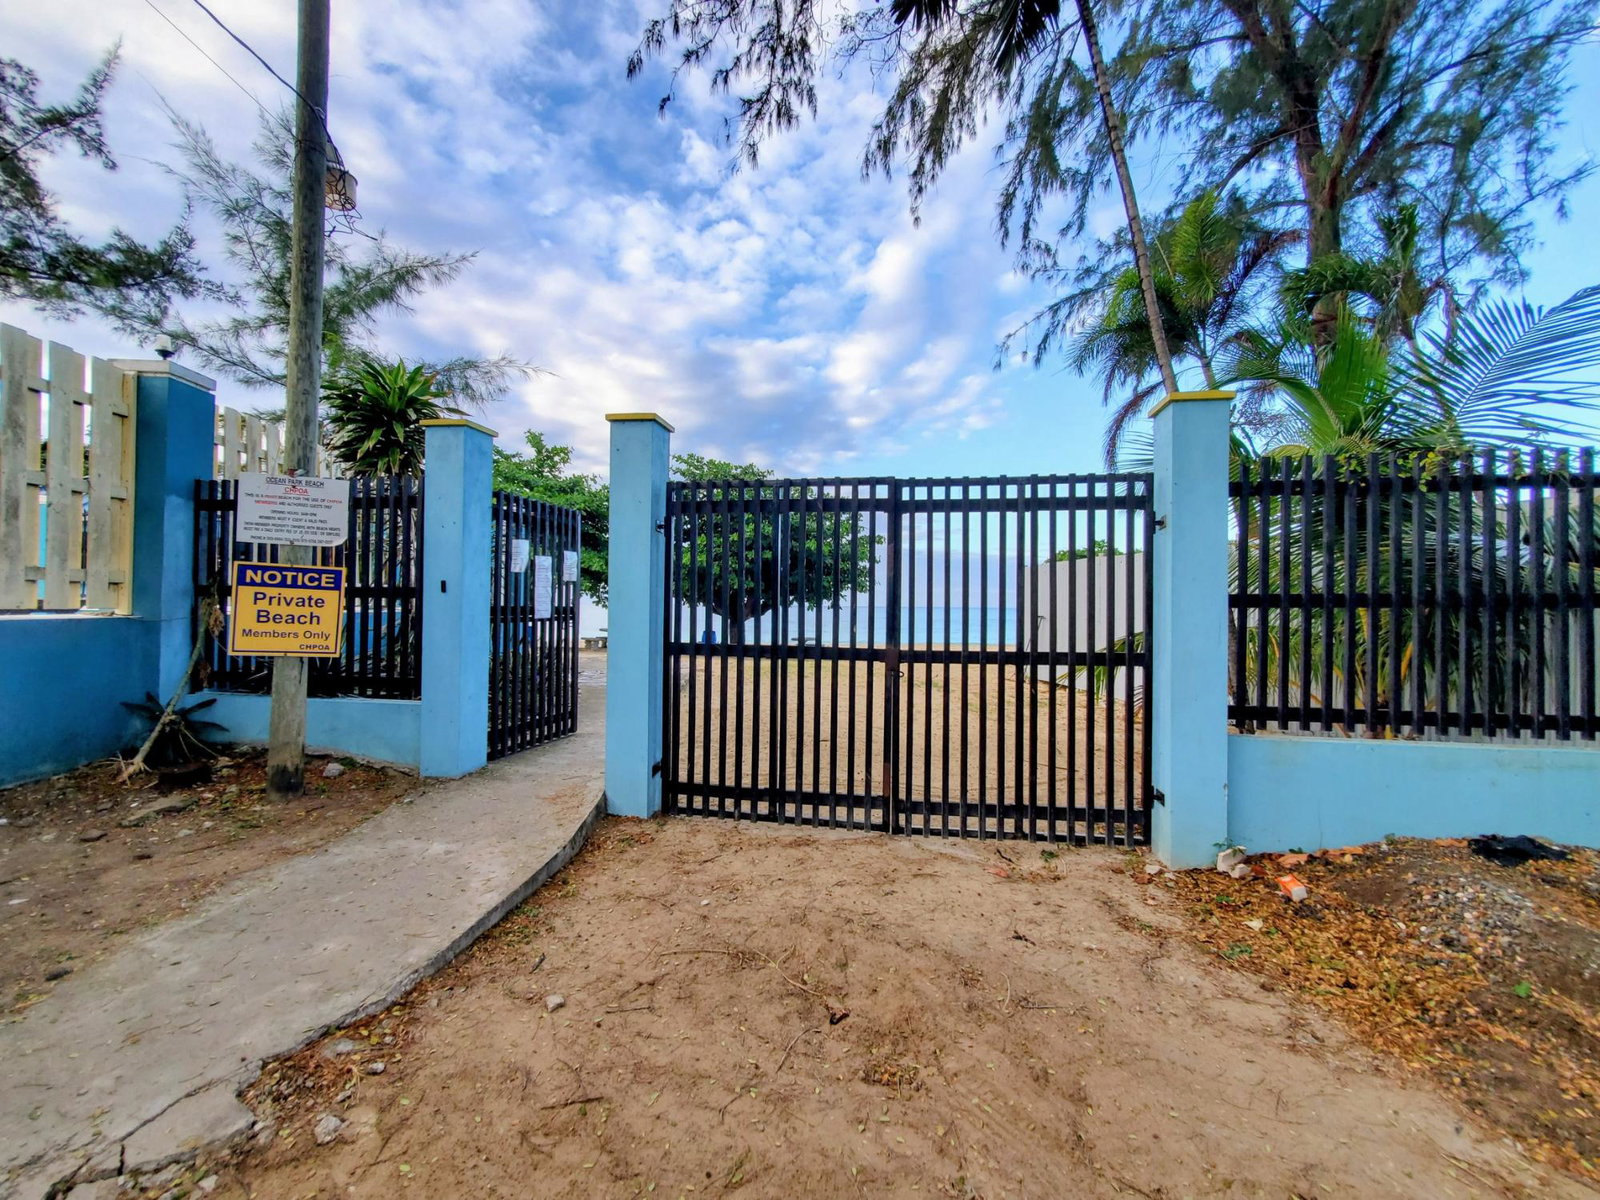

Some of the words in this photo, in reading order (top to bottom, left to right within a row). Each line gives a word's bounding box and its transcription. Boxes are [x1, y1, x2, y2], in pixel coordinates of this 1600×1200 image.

[266, 477, 286, 485] OCEAN
[288, 478, 303, 486] PARK
[305, 479, 324, 487] BEACH
[245, 569, 335, 587] NOTICE
[253, 592, 325, 608] Private
[256, 609, 320, 625] Beach
[242, 629, 299, 639] Members
[303, 630, 330, 641] Only
